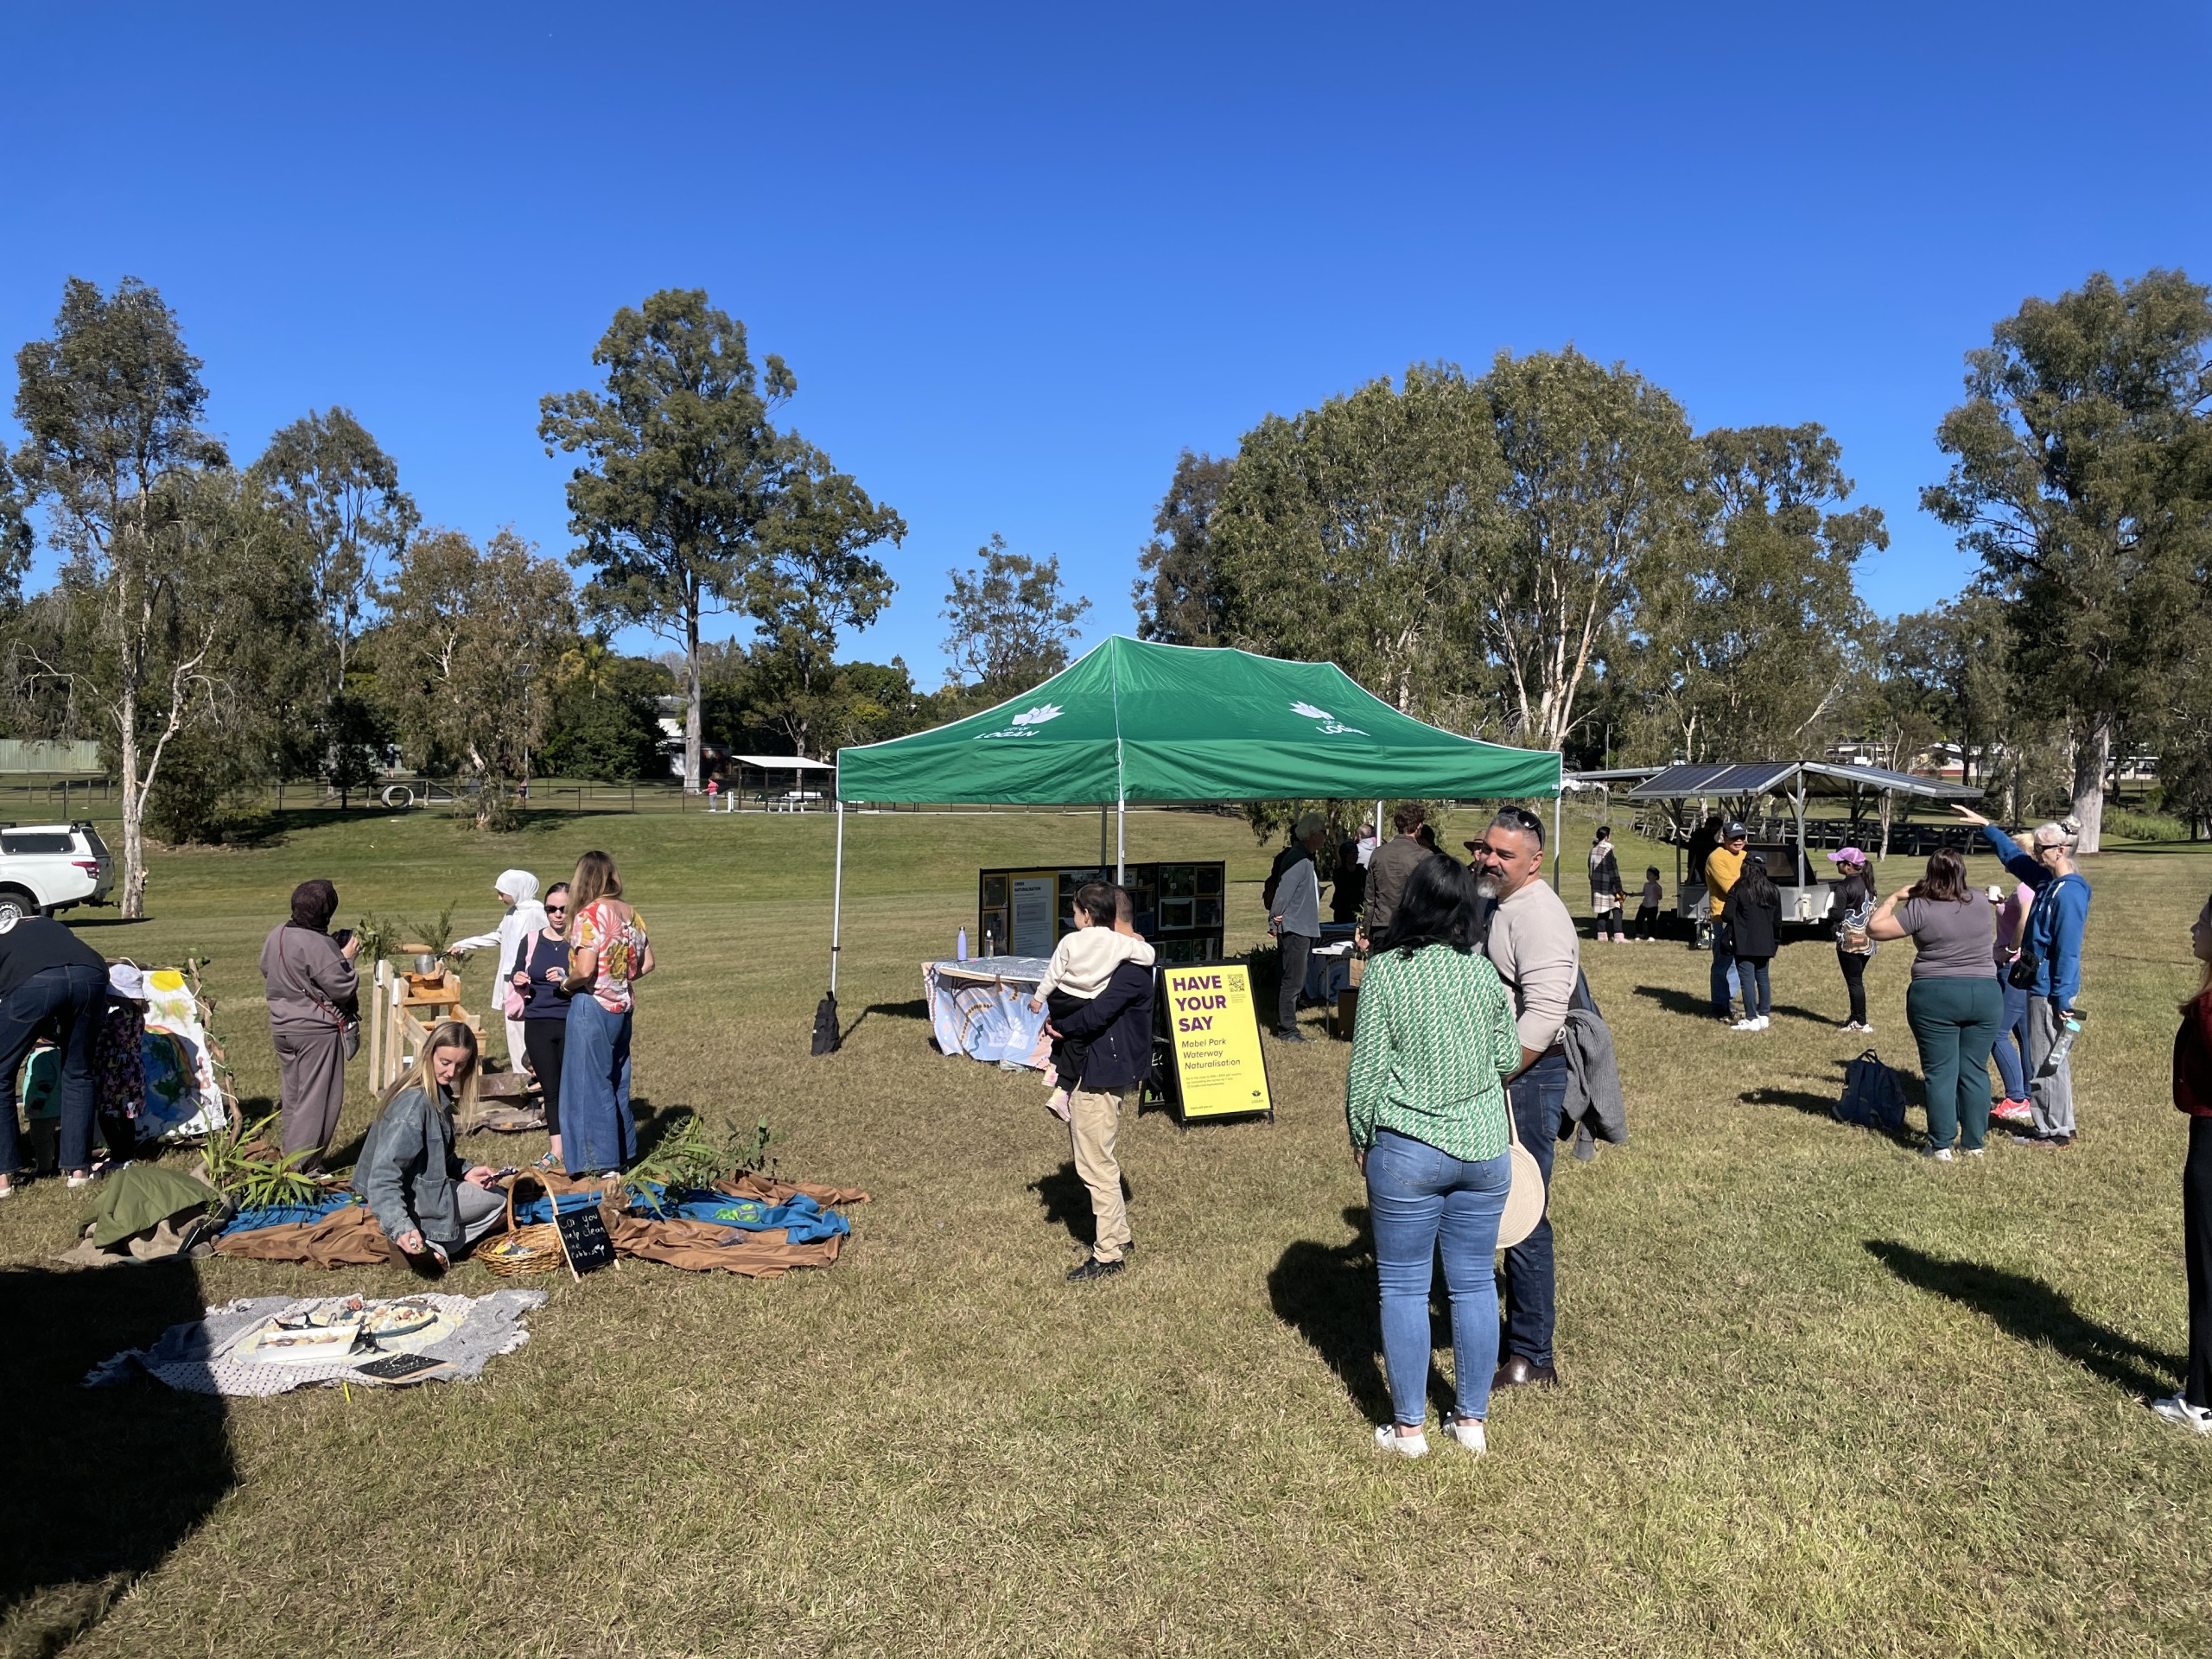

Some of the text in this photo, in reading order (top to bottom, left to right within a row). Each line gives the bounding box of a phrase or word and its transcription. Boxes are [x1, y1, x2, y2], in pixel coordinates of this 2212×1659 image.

[1173, 976, 1223, 992] HAVE
[1175, 995, 1227, 1012] YOUR
[1179, 1016, 1213, 1033] SAY
[1181, 1039, 1206, 1048] Mabel
[1183, 1050, 1224, 1059] Waterway
[1185, 1058, 1241, 1070] Naturalisation
[582, 1213, 598, 1227] you
[582, 1227, 606, 1236] clean
